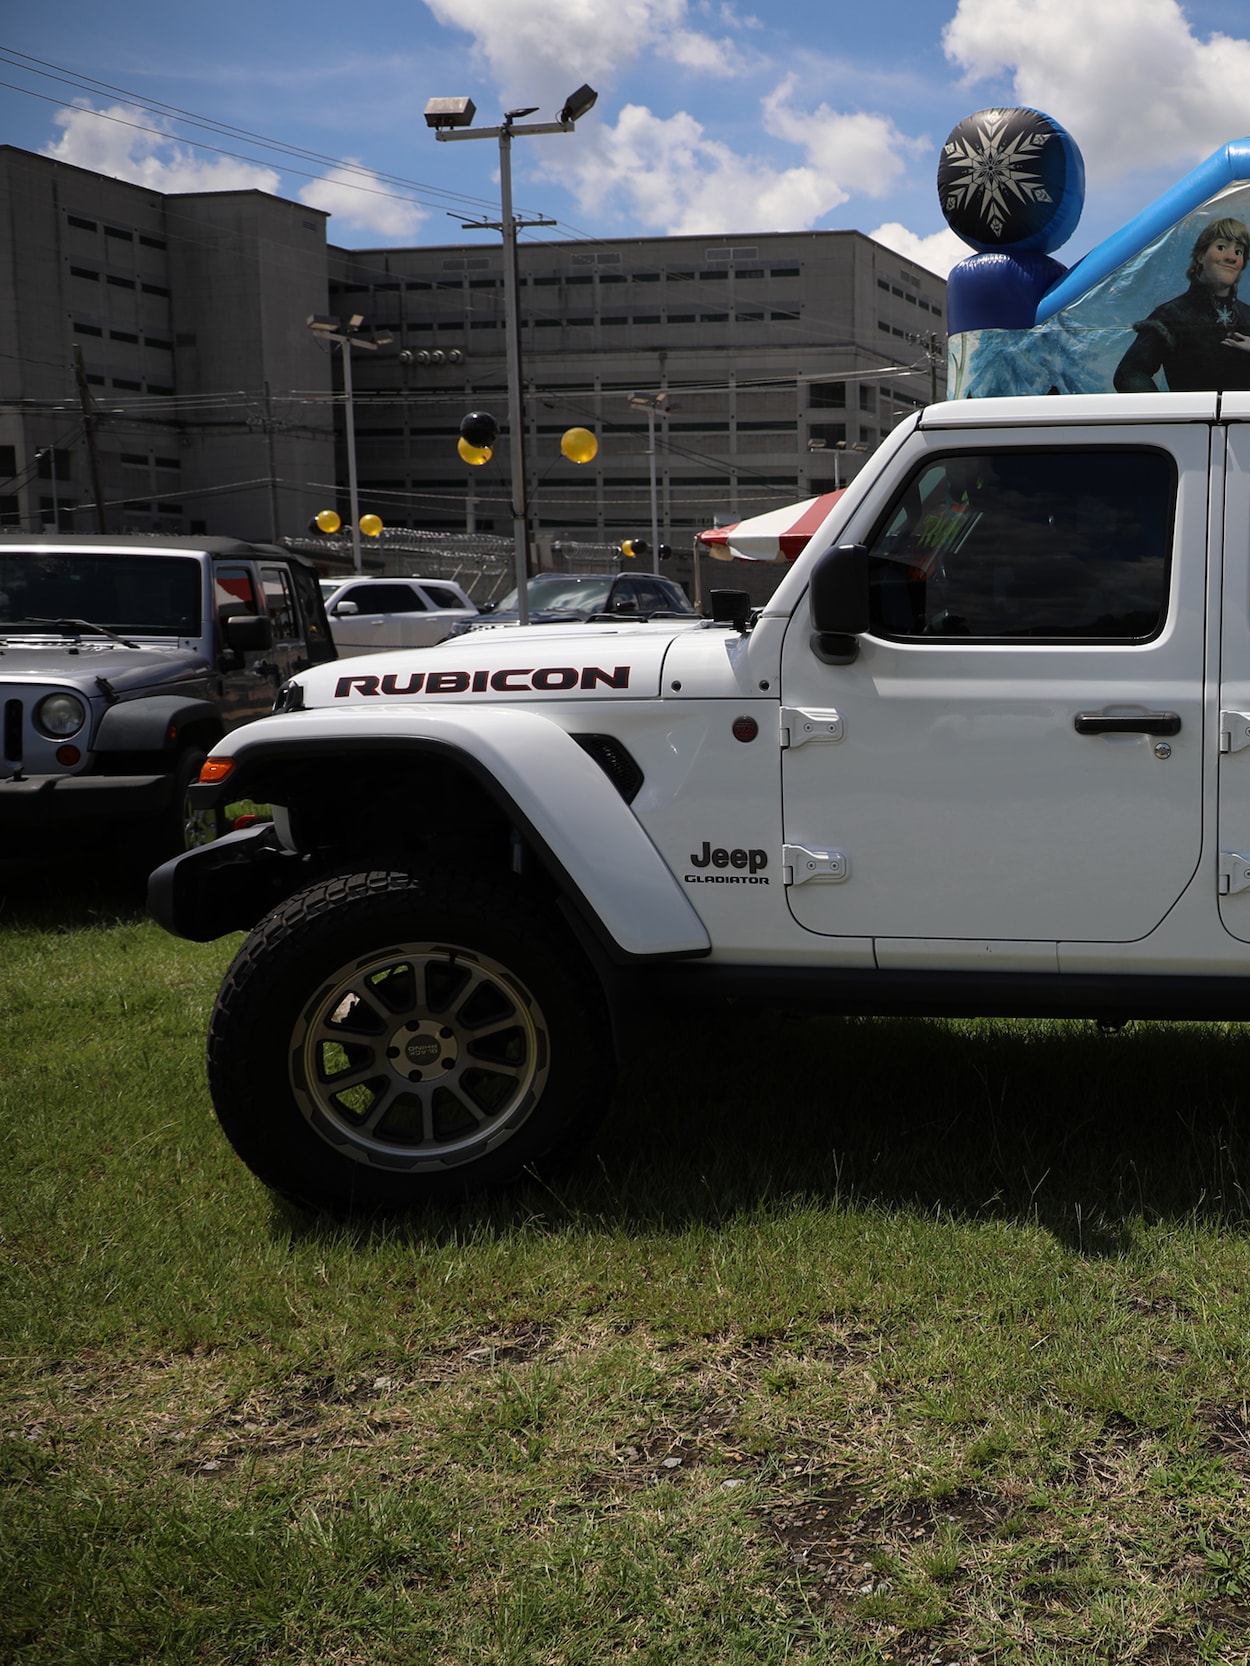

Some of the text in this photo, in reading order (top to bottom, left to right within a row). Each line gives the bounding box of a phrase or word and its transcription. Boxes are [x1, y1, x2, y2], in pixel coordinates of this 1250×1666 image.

[334, 666, 631, 698] RUBICON
[690, 841, 768, 874] Jeep
[684, 875, 770, 885] GLADIATOR
